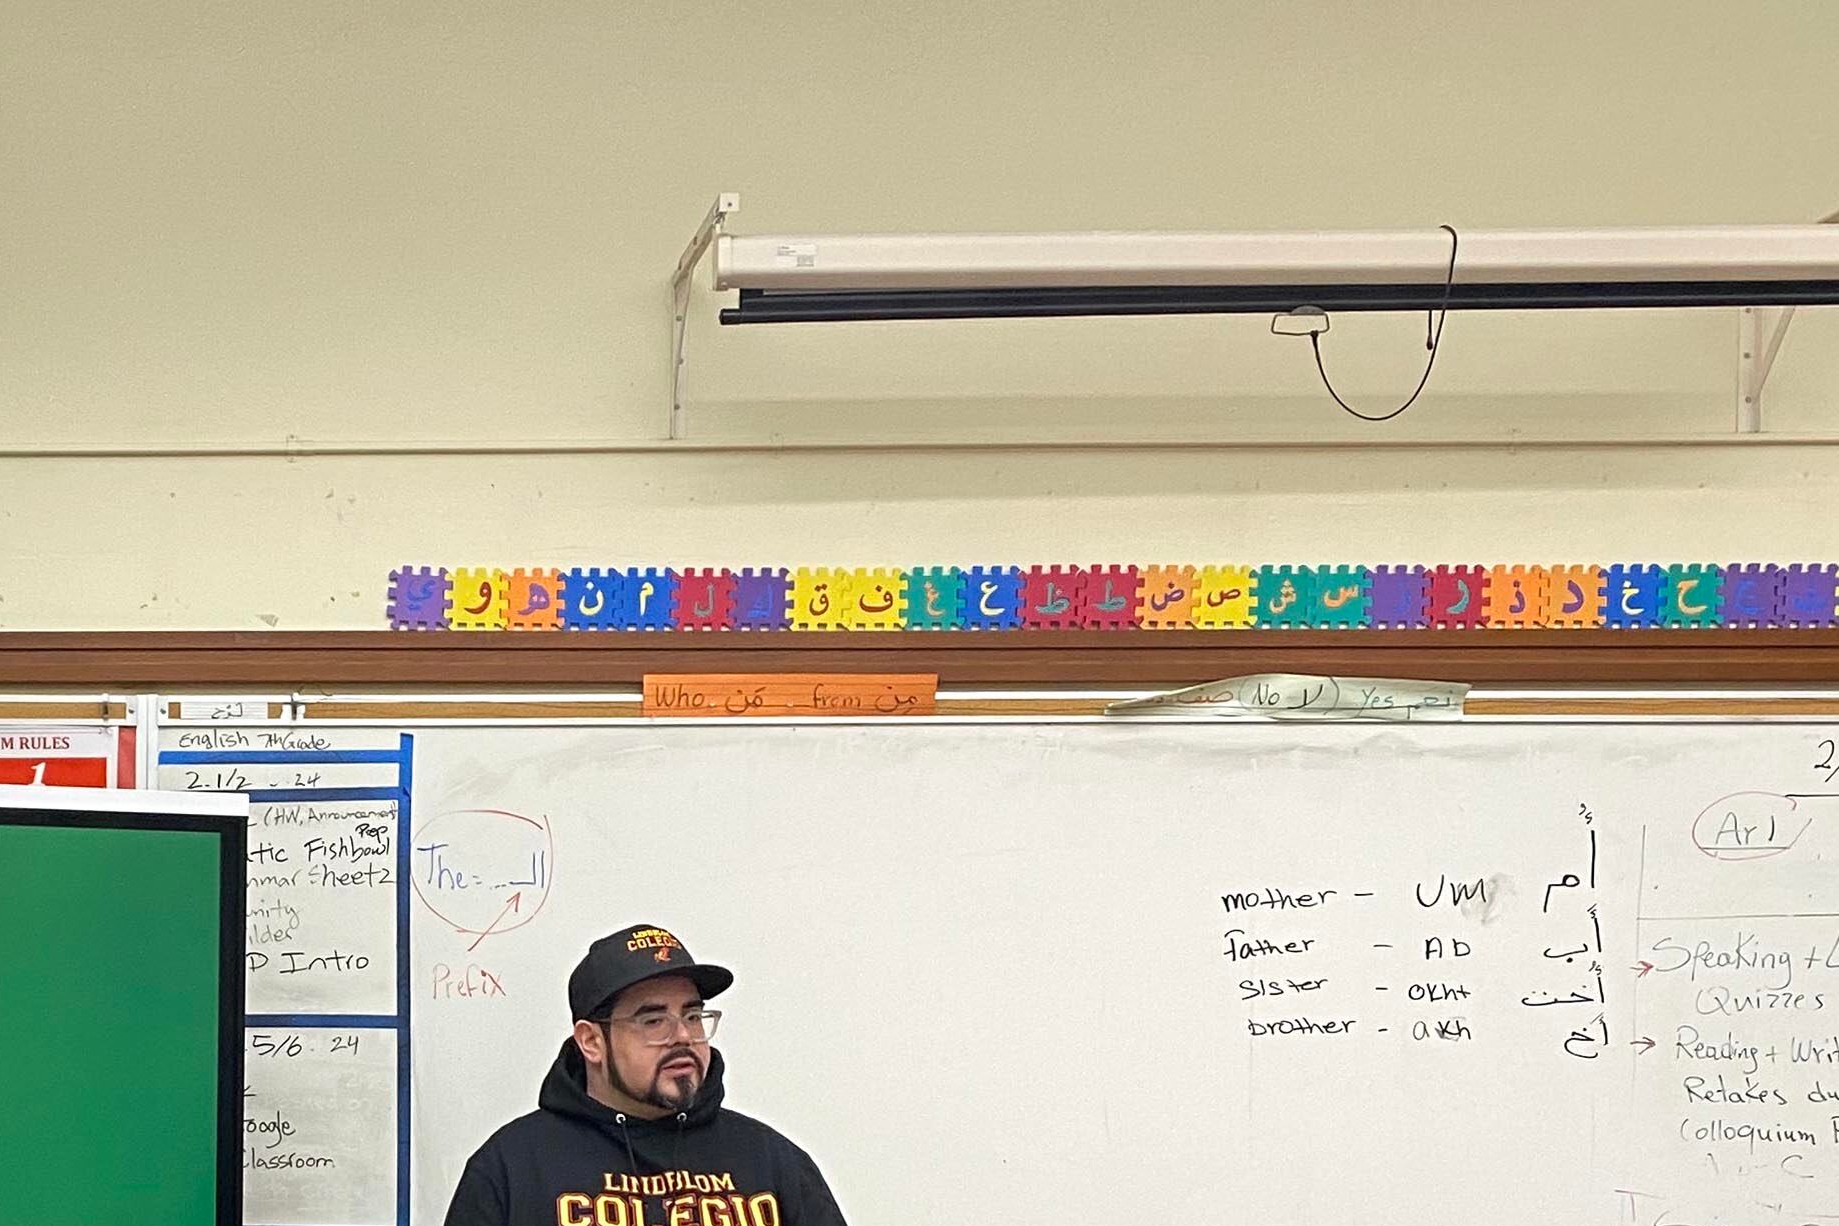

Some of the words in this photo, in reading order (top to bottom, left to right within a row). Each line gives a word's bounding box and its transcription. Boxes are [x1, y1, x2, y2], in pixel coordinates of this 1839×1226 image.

[464, 581, 492, 615] و
[578, 581, 604, 616] ن
[639, 581, 655, 616] م
[809, 583, 830, 616] ق
[859, 585, 894, 613] ف
[980, 581, 1005, 615] ع
[1151, 581, 1185, 611] ض
[1207, 588, 1242, 607] ص
[1269, 578, 1297, 614] ش
[1324, 584, 1359, 608] س
[1562, 579, 1585, 614] د
[1621, 580, 1645, 615] خ
[656, 683, 703, 708] Who
[813, 682, 861, 708] from
[1252, 682, 1281, 706] No
[1360, 687, 1395, 710] Yes
[19, 736, 70, 750] RULES
[178, 728, 249, 749] English
[246, 843, 289, 864] tic
[303, 837, 390, 863] Fishbowl
[246, 898, 301, 929] nity
[1221, 888, 1338, 912] mother
[1223, 929, 1315, 962] father
[279, 949, 370, 974] Intro
[432, 962, 507, 1000] Prefix
[1696, 986, 1825, 1016] Quizzes
[1248, 1017, 1357, 1037] brother
[1676, 1025, 1759, 1075] Reading
